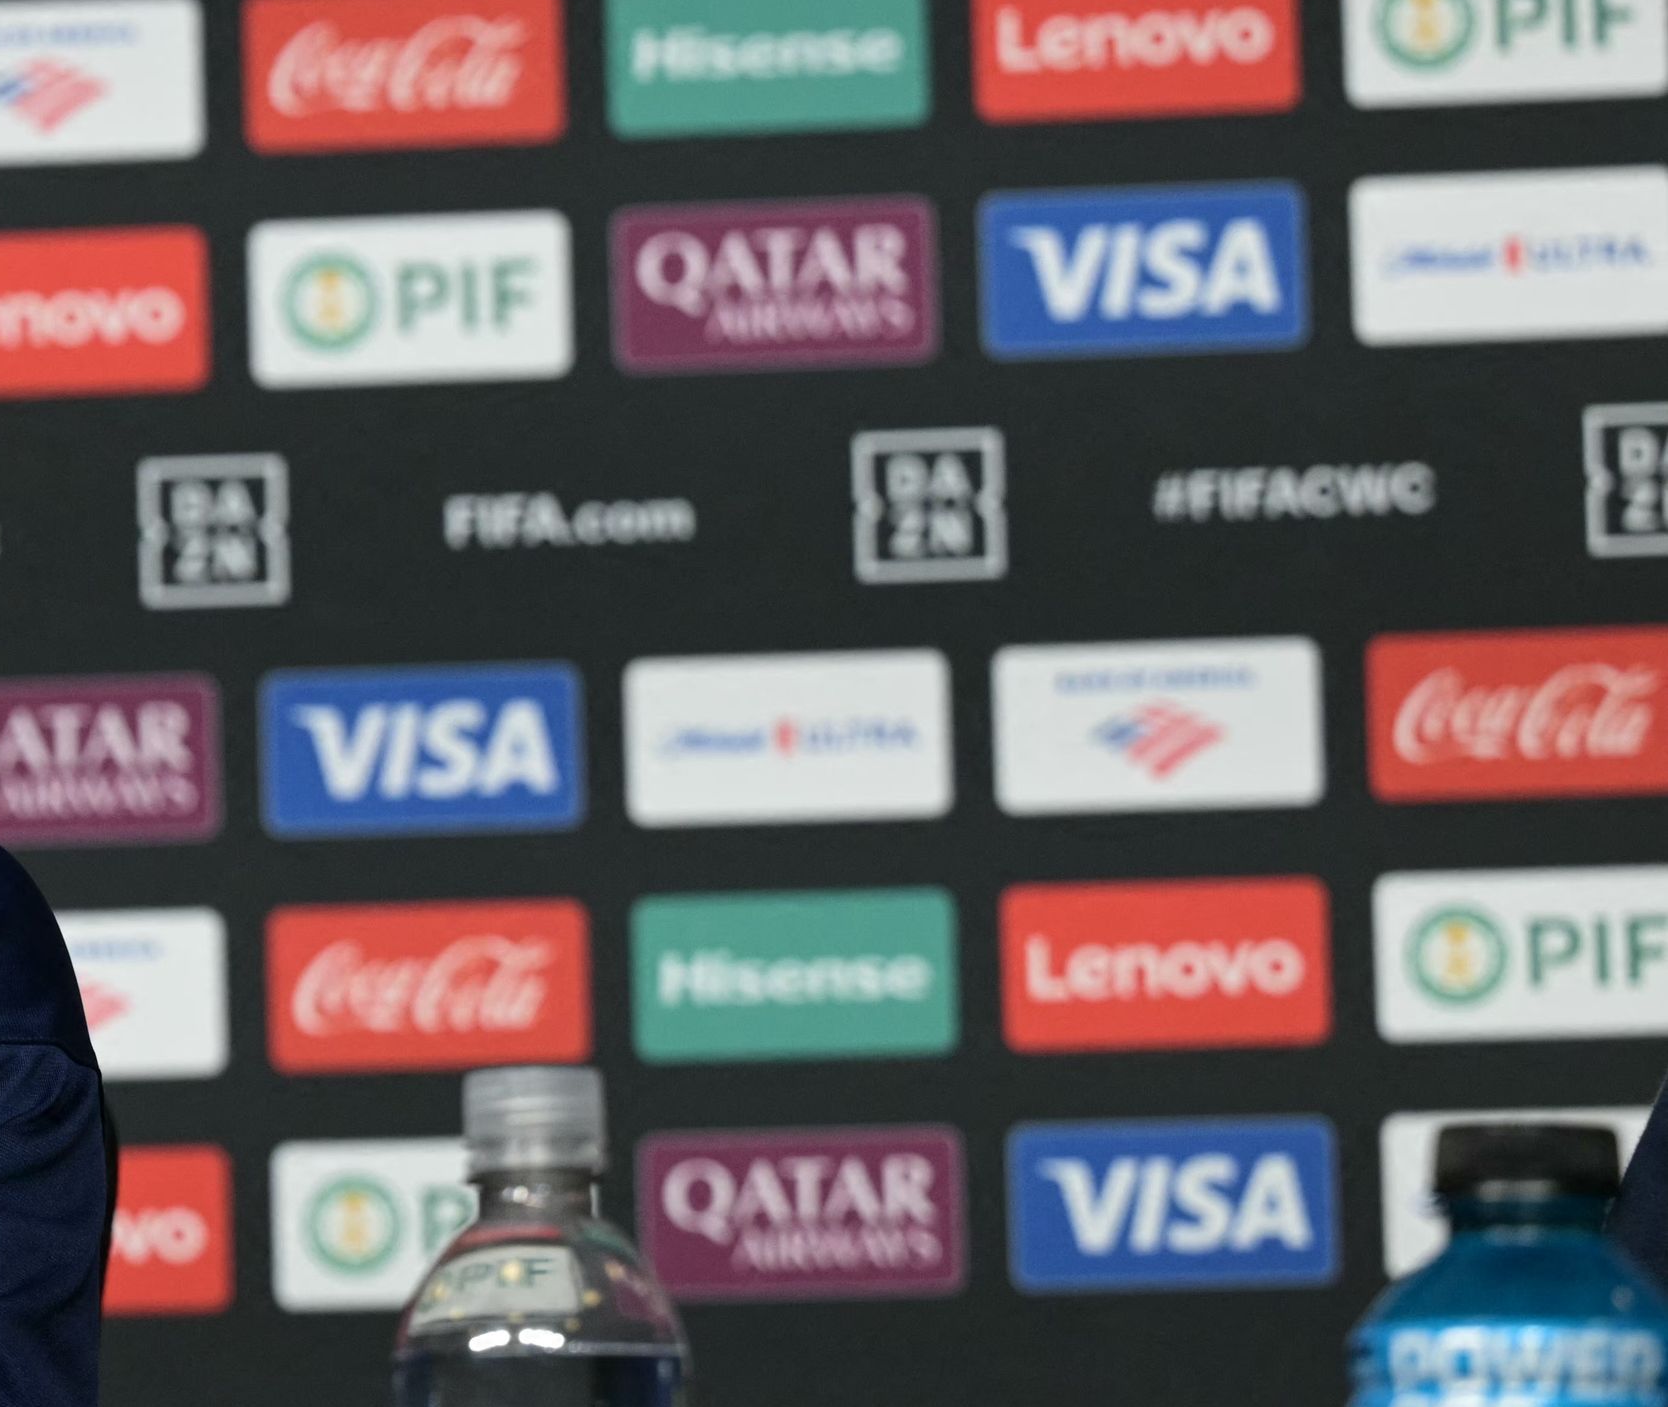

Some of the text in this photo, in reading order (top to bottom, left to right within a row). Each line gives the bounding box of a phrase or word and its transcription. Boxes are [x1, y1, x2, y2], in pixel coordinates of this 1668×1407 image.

[630, 28, 904, 81] Hisense
[994, 7, 1275, 73] Lenovo
[393, 257, 535, 334] PIF
[635, 223, 911, 318] QATAR
[1019, 219, 1281, 321] VISA
[1617, 429, 1668, 477] D
[445, 494, 694, 546] FIFA.com
[1155, 463, 1431, 518] #FIFACWC
[301, 700, 558, 800] VISA
[657, 953, 932, 1005] Hisense
[1024, 936, 1306, 1002] Lenovo
[1525, 913, 1668, 989] PIF
[659, 1150, 938, 1246] QATAR
[1047, 1154, 1312, 1254] VISA
[1388, 1324, 1664, 1398] POWER
